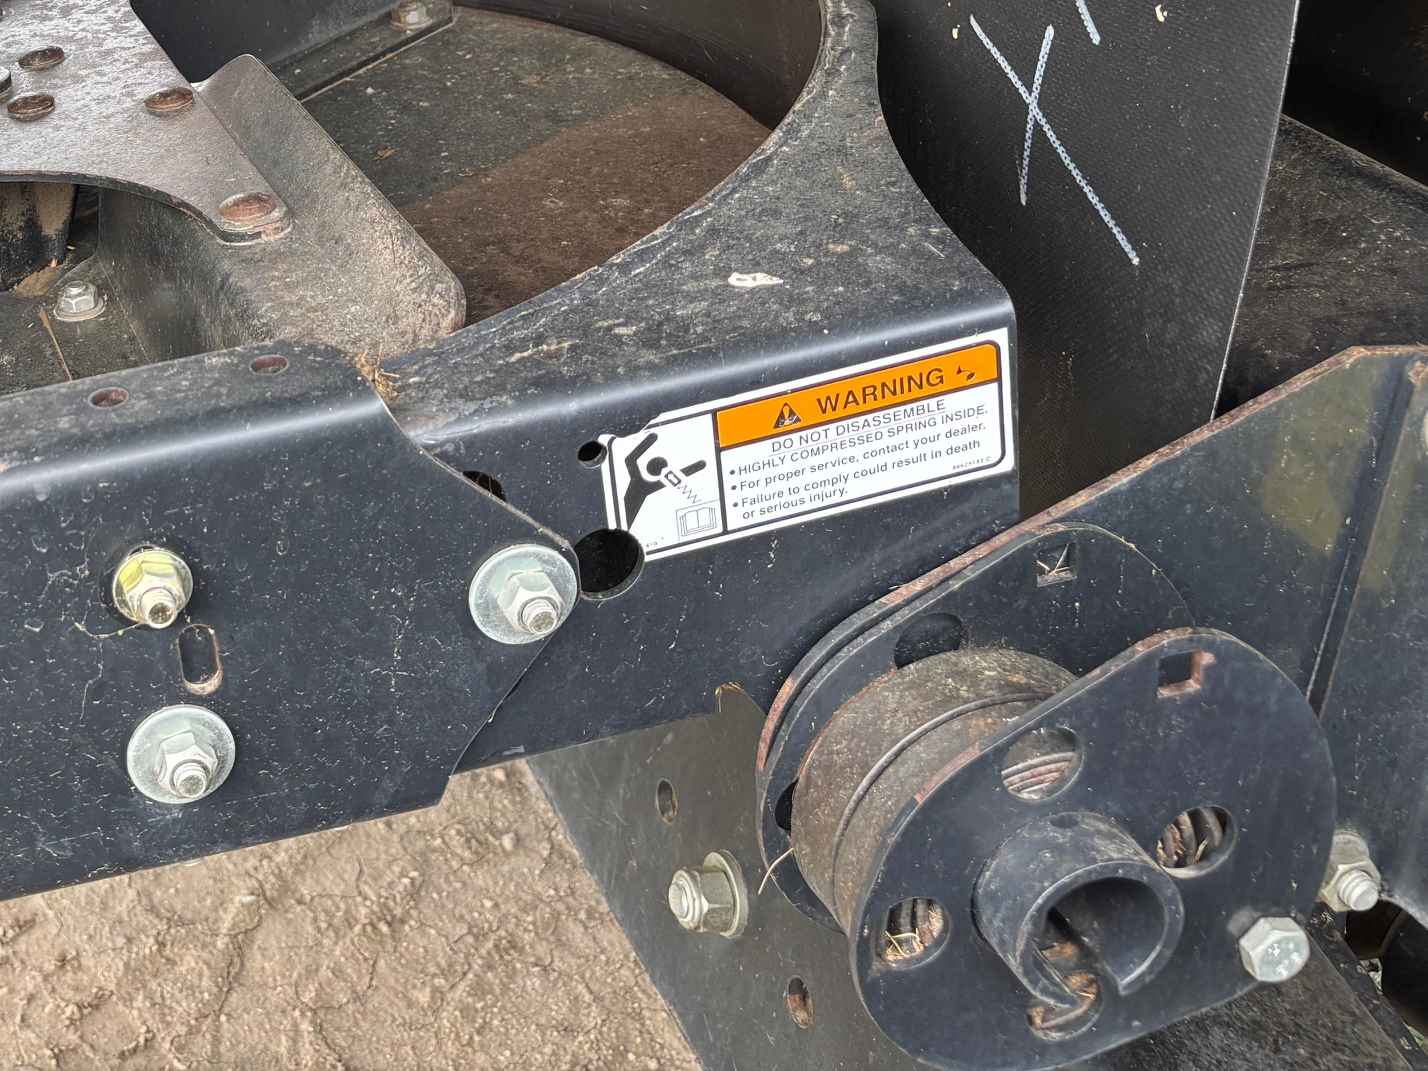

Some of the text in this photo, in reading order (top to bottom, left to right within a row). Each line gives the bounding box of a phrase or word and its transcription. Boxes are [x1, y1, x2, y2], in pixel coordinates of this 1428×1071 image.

[816, 367, 944, 415] WARNING
[739, 405, 988, 476] HIGHLY COMPRESSED SPRING INSIDE.
[772, 399, 946, 453] DO NOT DISASSEMBLE
[740, 423, 986, 491] For proper service, contact your dealer.
[741, 440, 980, 507] Failure to comply could result in death
[742, 487, 848, 519] or serious injury.
